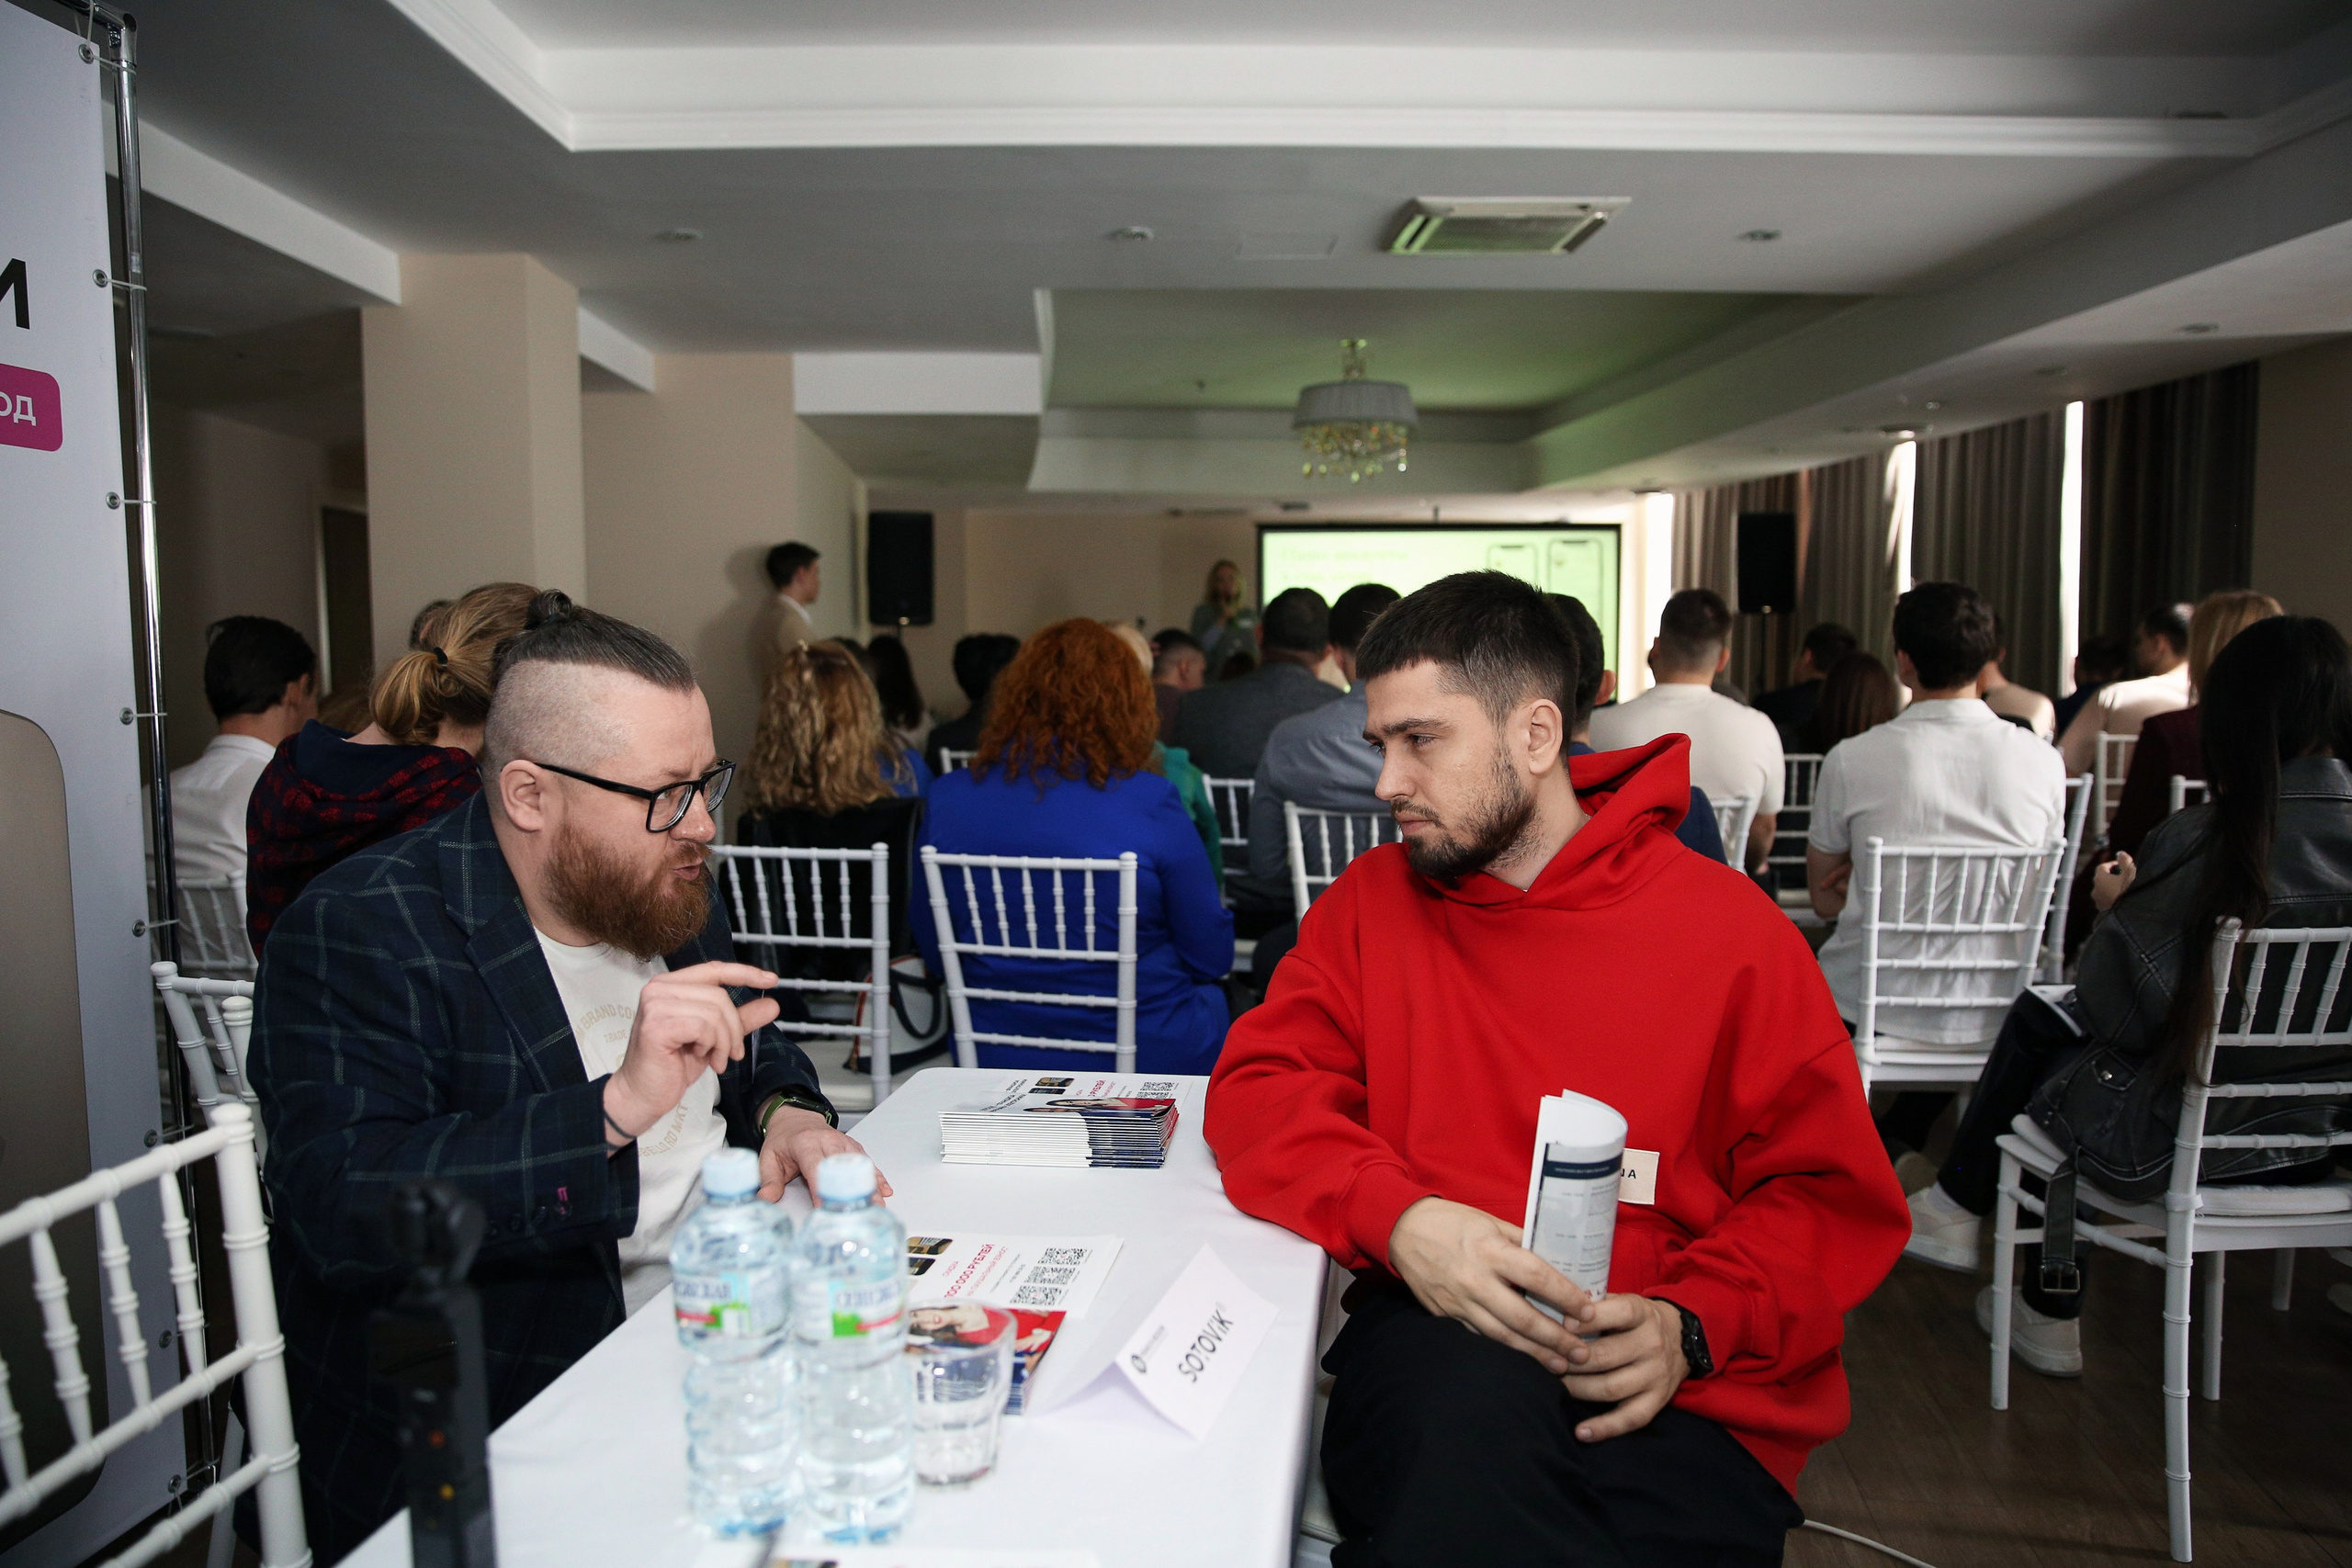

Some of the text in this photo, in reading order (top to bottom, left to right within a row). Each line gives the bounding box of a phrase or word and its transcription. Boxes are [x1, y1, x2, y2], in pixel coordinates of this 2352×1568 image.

[581, 1003, 616, 1030] BRAND
[944, 1244, 995, 1299] 100 000 РУБЛЕЙ
